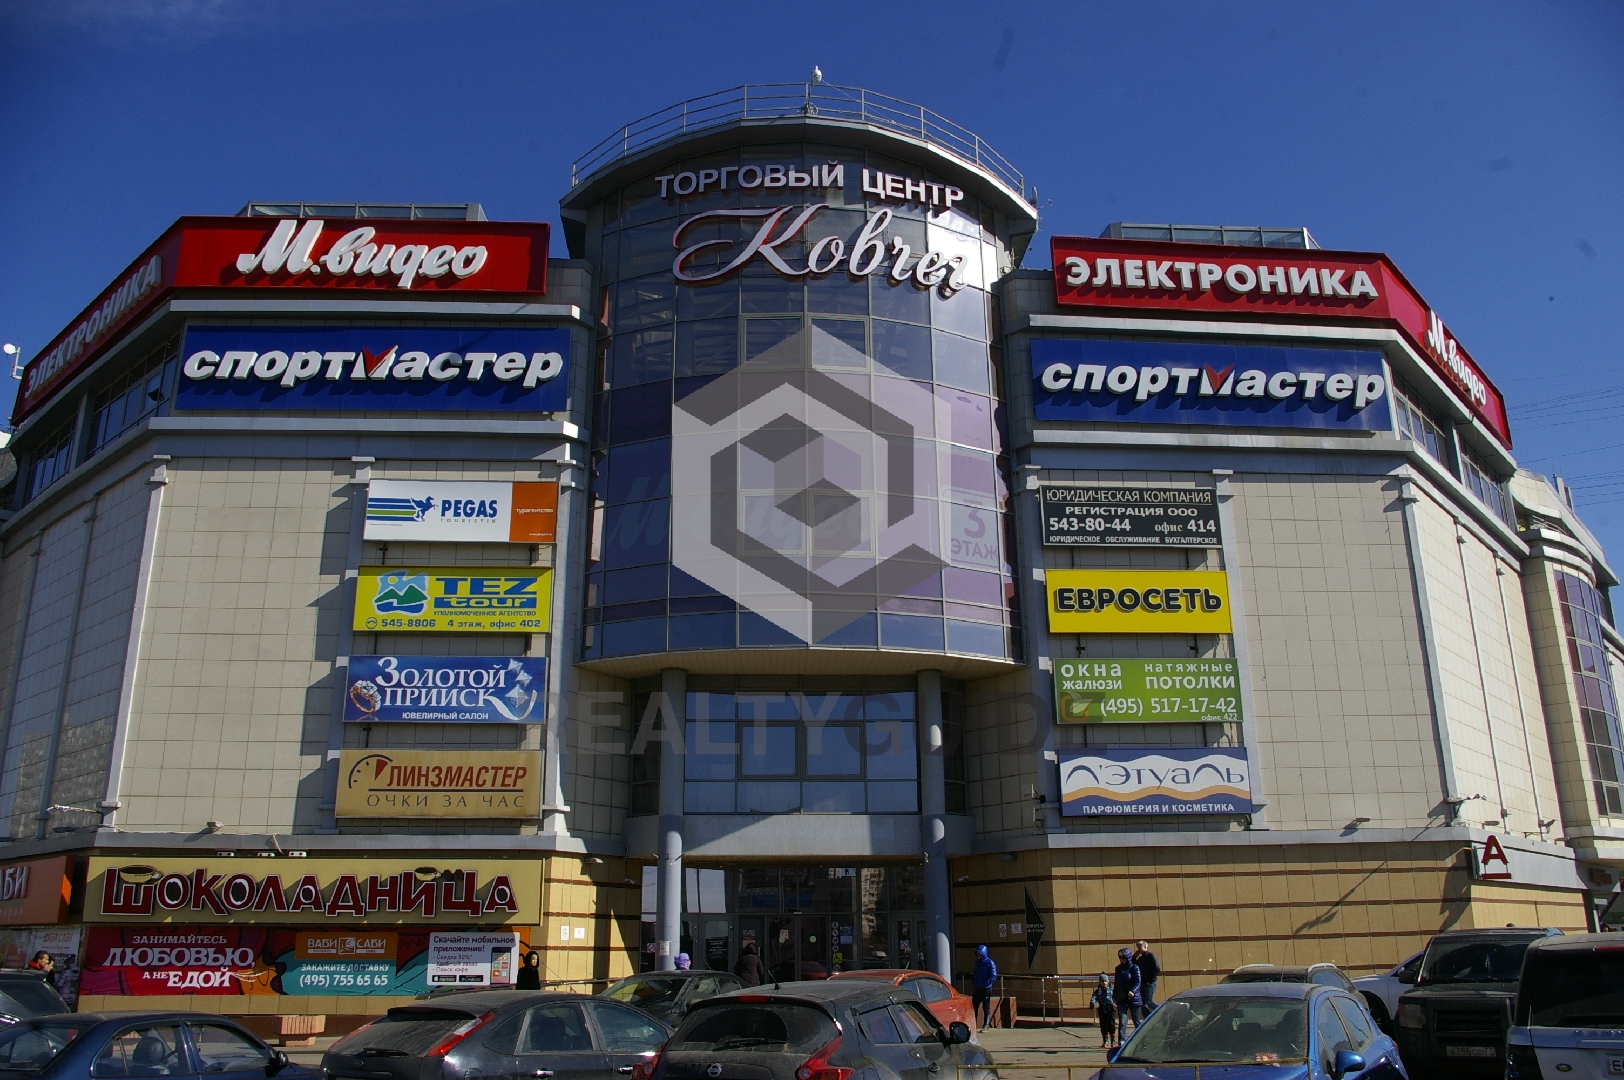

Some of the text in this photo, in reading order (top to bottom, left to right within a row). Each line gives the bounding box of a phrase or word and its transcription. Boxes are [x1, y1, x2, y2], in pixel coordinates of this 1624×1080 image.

[655, 160, 964, 208] ТОРГОВЫЙ ЦЕНТР
[236, 219, 488, 289] М.видео
[1064, 256, 1379, 299] ЭЛЕКТРОНИКА
[25, 255, 162, 399] ЭЛЕКТРОНИКА
[1046, 489, 1212, 503] ЮРИДИЧЕСКАЯ КОМПАНИЯ
[440, 499, 498, 518] PEGAS
[1065, 506, 1198, 517] РЕГИСТРАЦИЯ ООО
[1049, 517, 1216, 534] 543-80-44 офис 414
[1049, 535, 1218, 544] ЮРИДИЧЕСКОЕ ОБСЛУЖИВАНИЕ БУХГАЛТЕРСКОЕ
[435, 577, 538, 595] TEZ
[444, 597, 528, 607] tour
[1056, 587, 1222, 611] ЕВРОСЕТЬ
[381, 618, 541, 630] 545-8806 4 этаж, офис 402
[1144, 663, 1233, 673] натяжные
[1062, 679, 1123, 690] жалюзи
[382, 687, 519, 713] ПРИИСК
[1100, 697, 1237, 716] (495) 517-17-42
[402, 711, 489, 720] ЮВЕЛИРНЫЙ САЛОН
[1201, 713, 1238, 721] офис 422
[387, 765, 528, 788] ЛИНЗМАСТЕР
[366, 794, 525, 808] ОЧКИ ЗА ЧАС
[1083, 803, 1235, 814] ПАРФЮМЕРИЯ И КОСМЕТИКА
[100, 866, 520, 918] ШОКОЛАДНИЦА
[132, 934, 228, 944] ЗАНИМАЙТЕСЬ
[307, 938, 387, 949] ВАБИ САБИ
[433, 935, 515, 944] Скачайте мобильное
[433, 945, 485, 953] приложение!
[102, 947, 256, 968] ЛЮБОВЬЮ,
[300, 963, 390, 973] ЗАКАЖИТЕ ДОСТАВКУ
[142, 967, 231, 989] А НЕ ЕДОЙ
[300, 974, 389, 988] (495) 755 65 65
